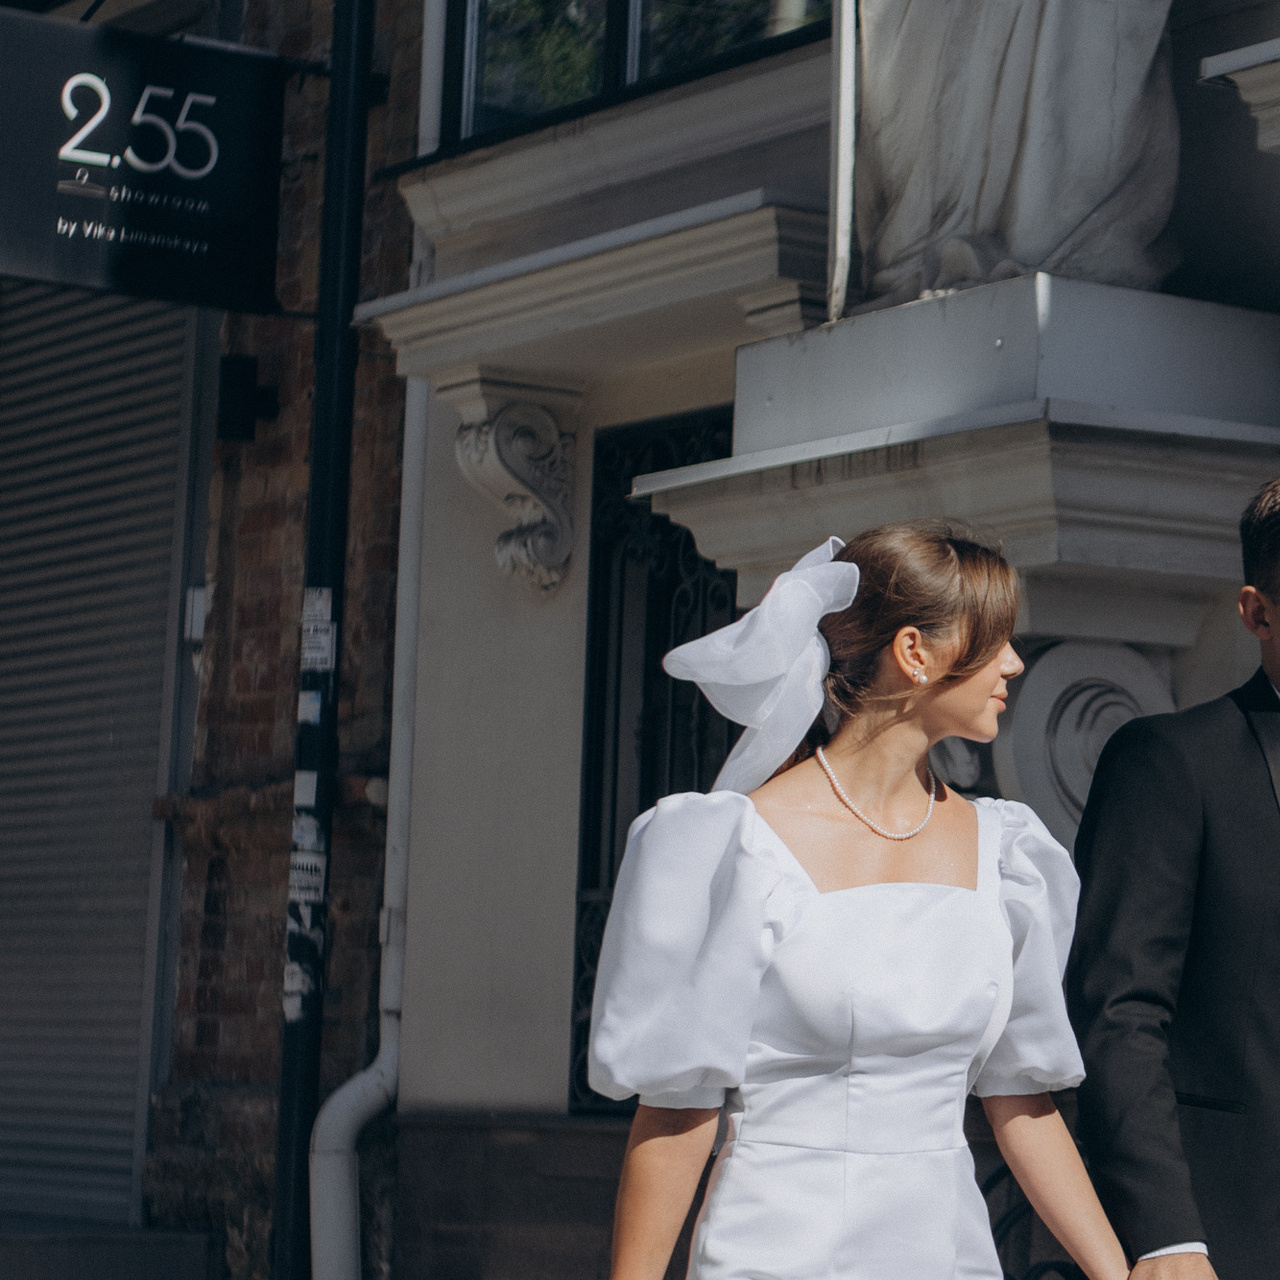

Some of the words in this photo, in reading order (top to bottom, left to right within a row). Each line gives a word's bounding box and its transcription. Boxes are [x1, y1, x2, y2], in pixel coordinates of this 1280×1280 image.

[57, 72, 219, 180] 2.55
[109, 184, 210, 213] showroom
[56, 216, 78, 239] by
[82, 219, 116, 242] Vika
